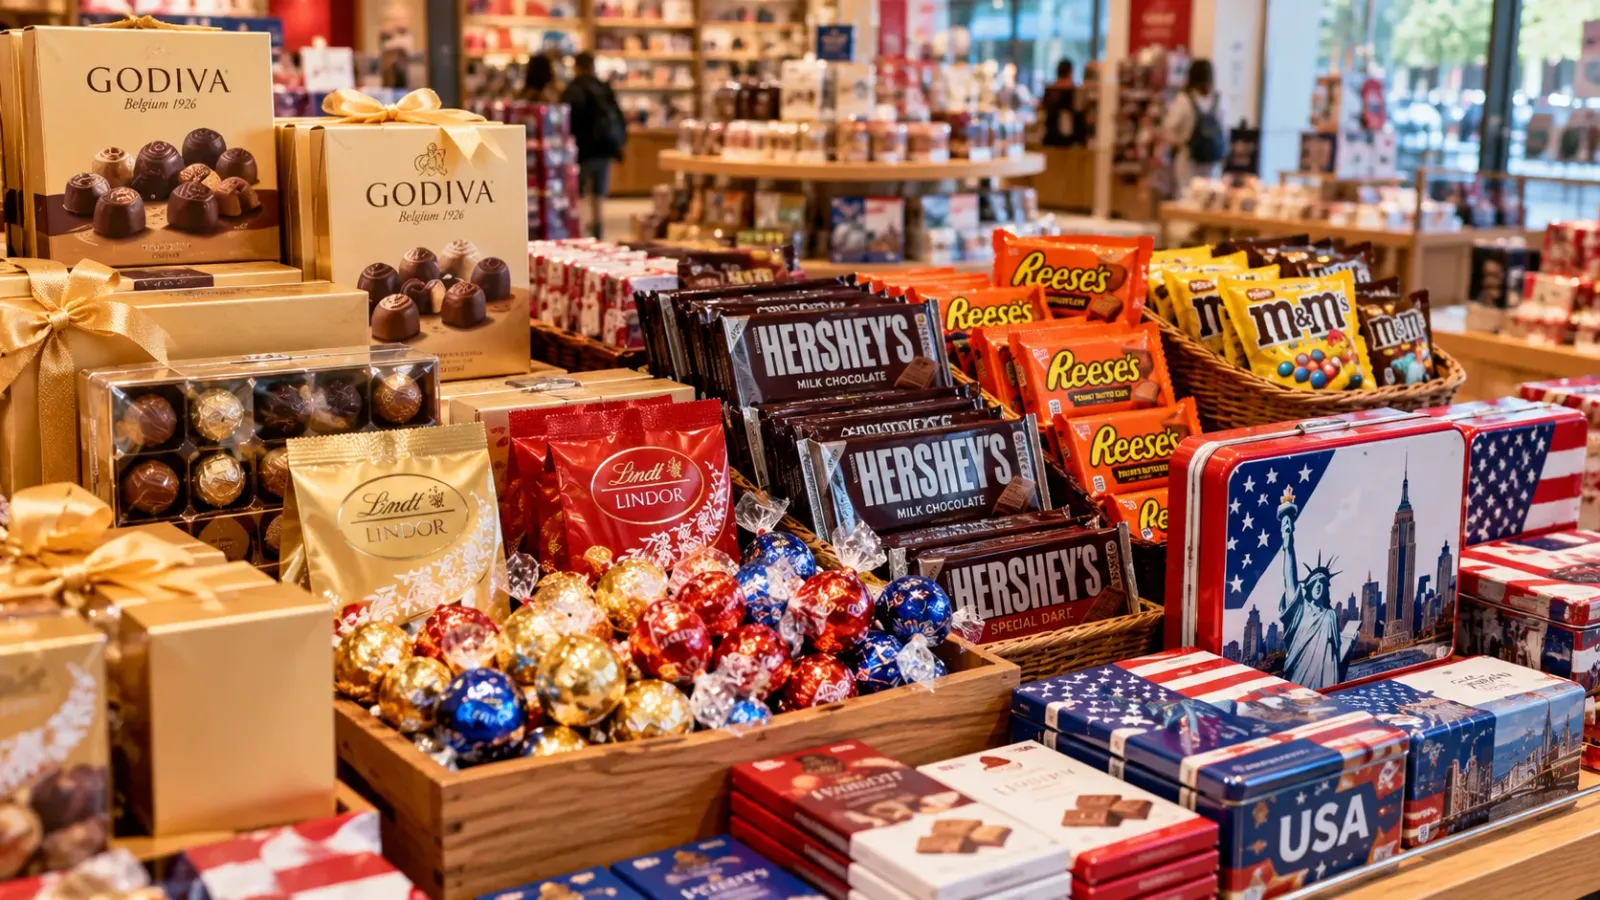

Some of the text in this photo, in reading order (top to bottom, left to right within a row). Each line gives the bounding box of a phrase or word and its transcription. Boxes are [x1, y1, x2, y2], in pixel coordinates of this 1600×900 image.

[87, 67, 230, 93] GODIVA
[124, 98, 196, 112] Belgium 1926
[366, 180, 494, 207] GODIVA
[399, 209, 464, 225] Belgium 1926
[1012, 251, 1111, 293] Reese's
[946, 296, 1033, 331] Reese's
[758, 314, 915, 377] HERSHEY'S
[797, 371, 887, 390] MILK CHOCOLATE
[1047, 349, 1140, 391] Reese's
[608, 460, 665, 486] Lindt
[855, 433, 1012, 507] HERSHEY'S
[357, 490, 426, 518] Lindt
[615, 487, 686, 510] LINDOR
[897, 495, 986, 519] MILK CHOCOLATE
[366, 518, 448, 543] LINDOR
[951, 543, 1102, 620] HERSHEY'S
[991, 615, 1038, 635] SPECIAL
[1279, 793, 1370, 863] USA
